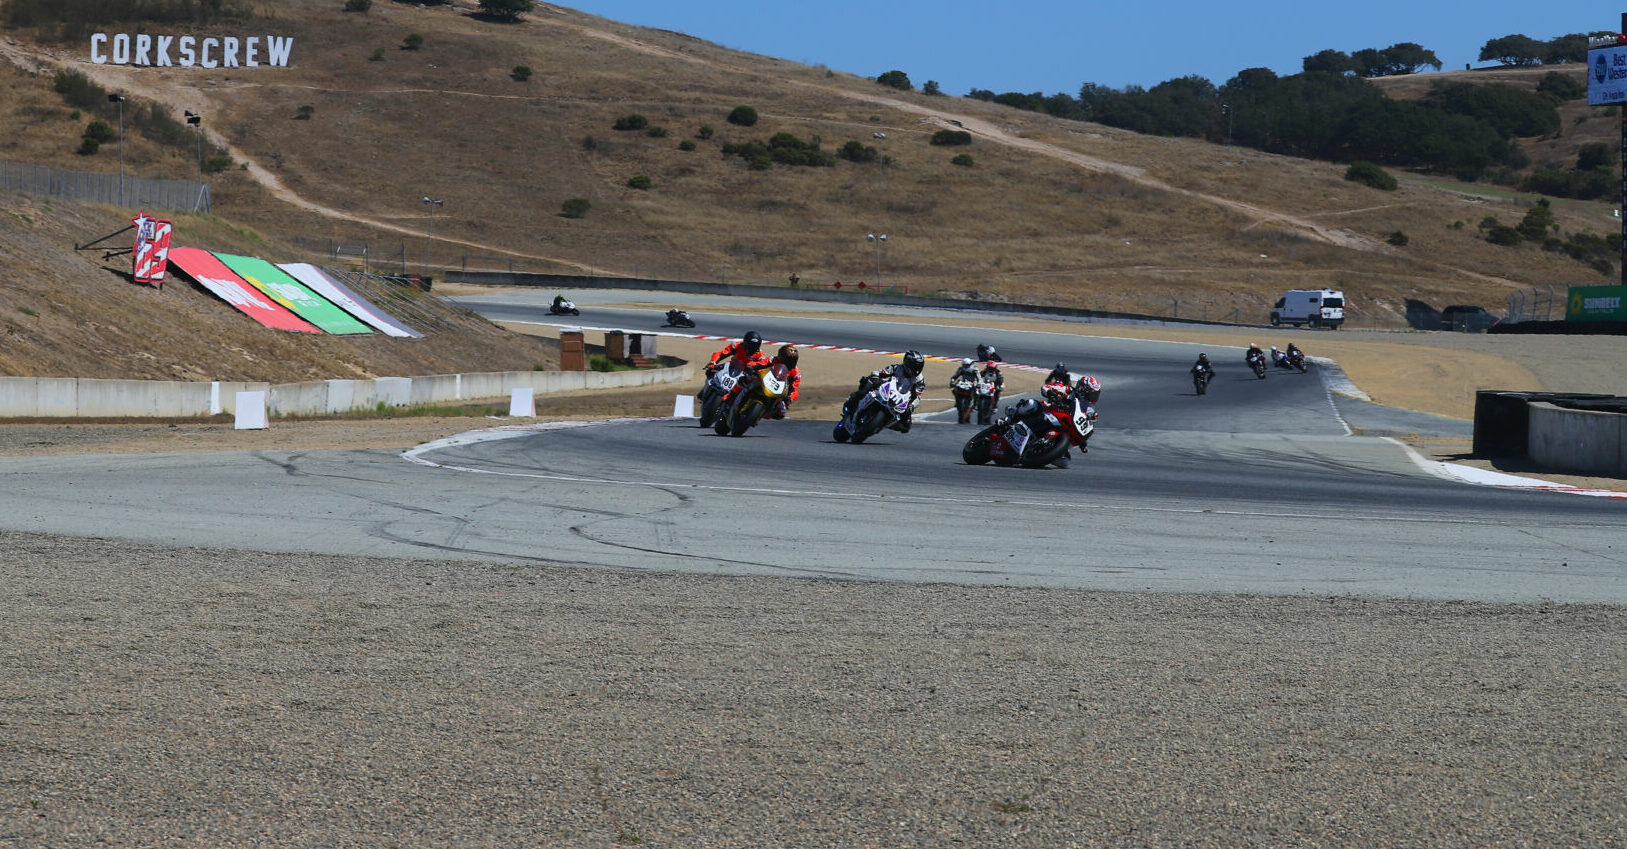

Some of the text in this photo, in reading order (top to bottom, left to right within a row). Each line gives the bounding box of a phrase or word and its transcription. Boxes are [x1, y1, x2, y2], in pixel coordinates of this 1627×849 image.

[90, 33, 294, 69] CORKSCREW
[721, 376, 735, 389] 188
[1075, 416, 1087, 431] 99
